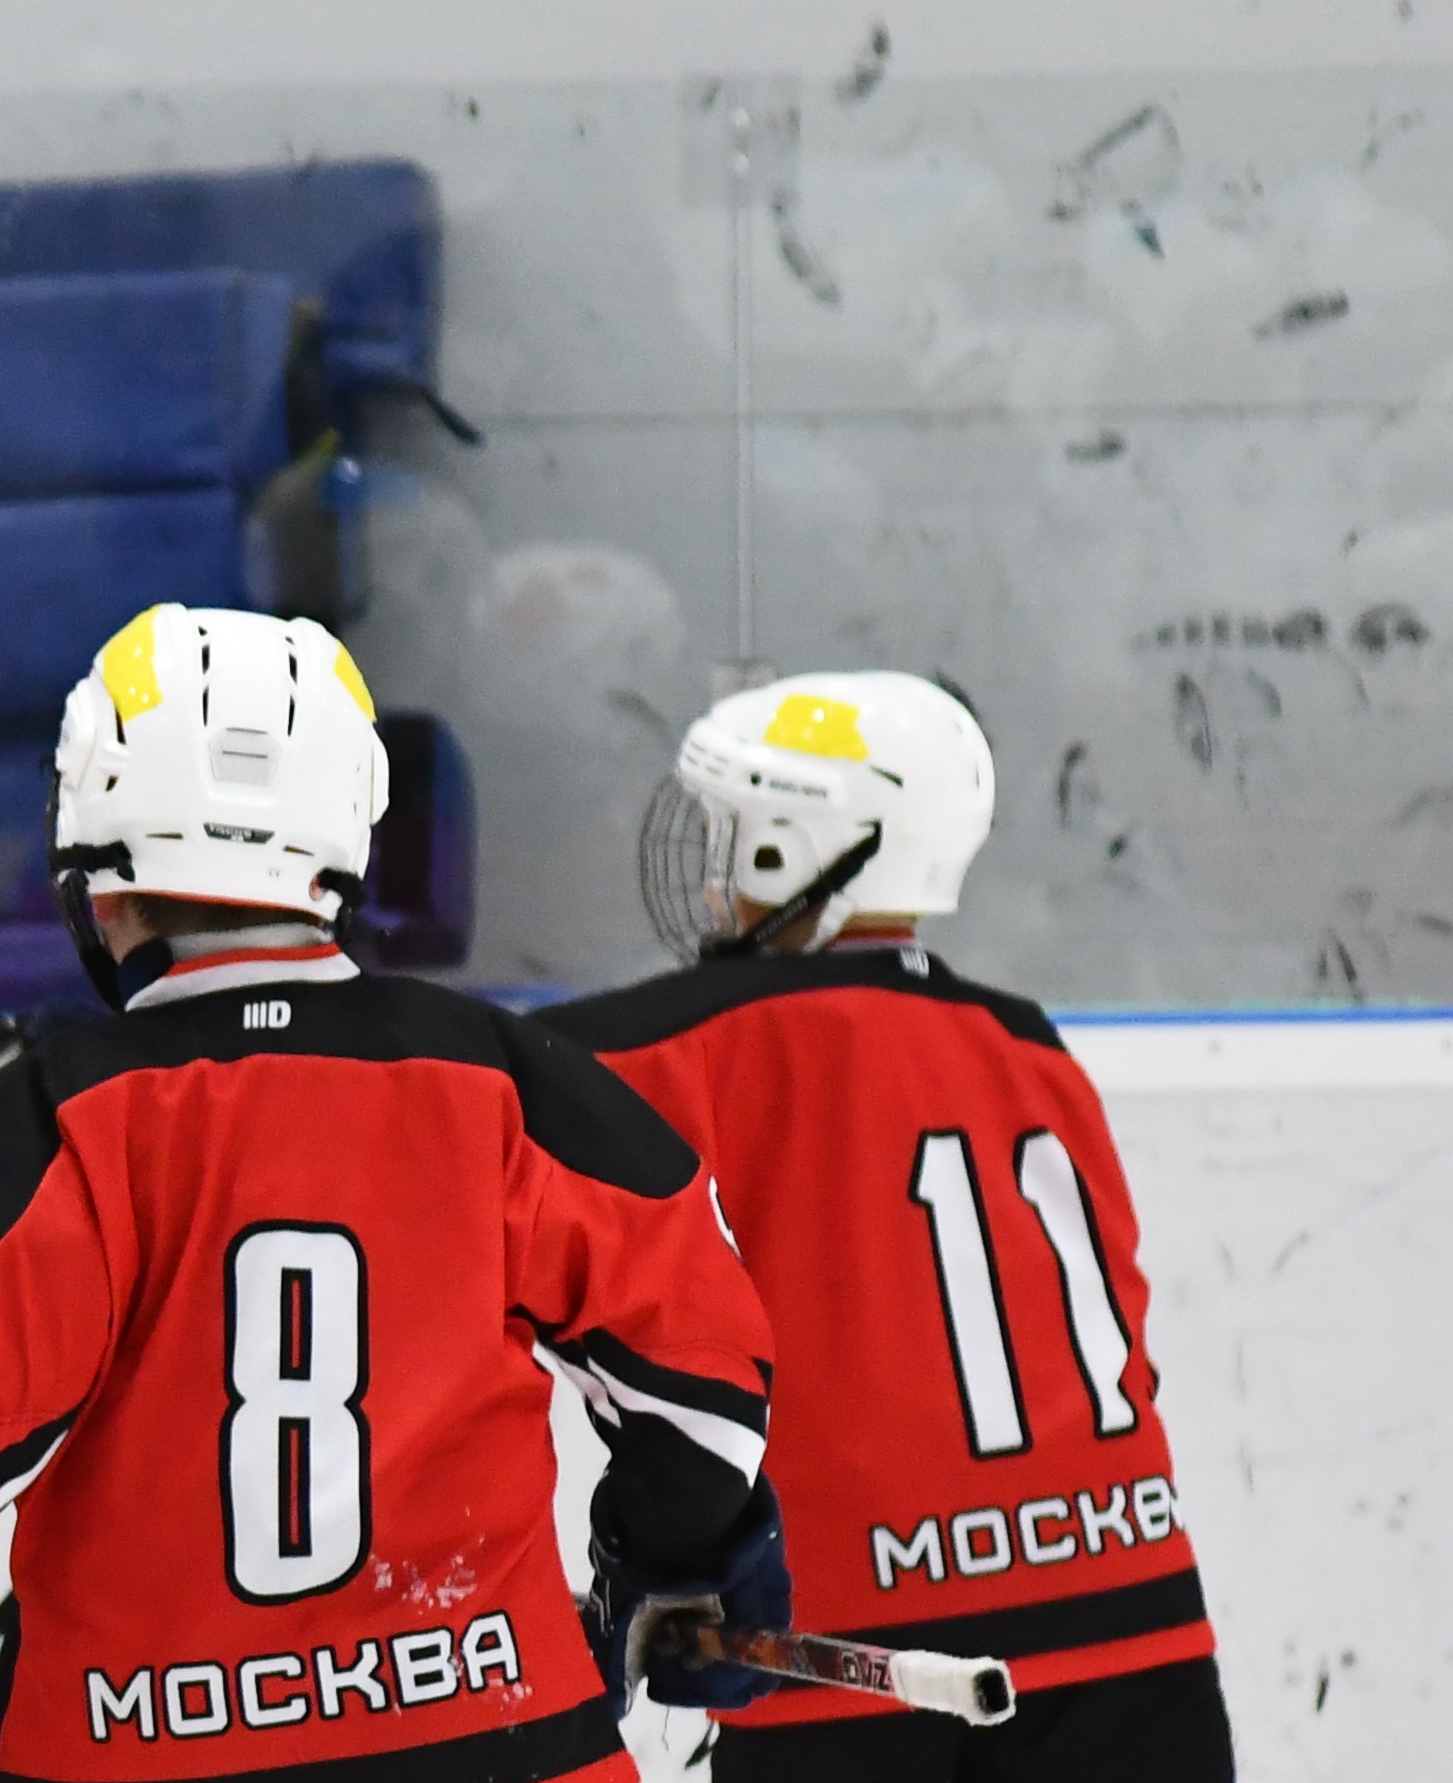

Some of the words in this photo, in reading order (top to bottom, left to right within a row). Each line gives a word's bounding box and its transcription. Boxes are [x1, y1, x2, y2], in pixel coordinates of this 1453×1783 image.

[908, 1128, 1138, 1460] 11
[220, 1220, 371, 1606] 8
[870, 1474, 1183, 1590] МОСКВ
[85, 1611, 522, 1743] МОСКВА
